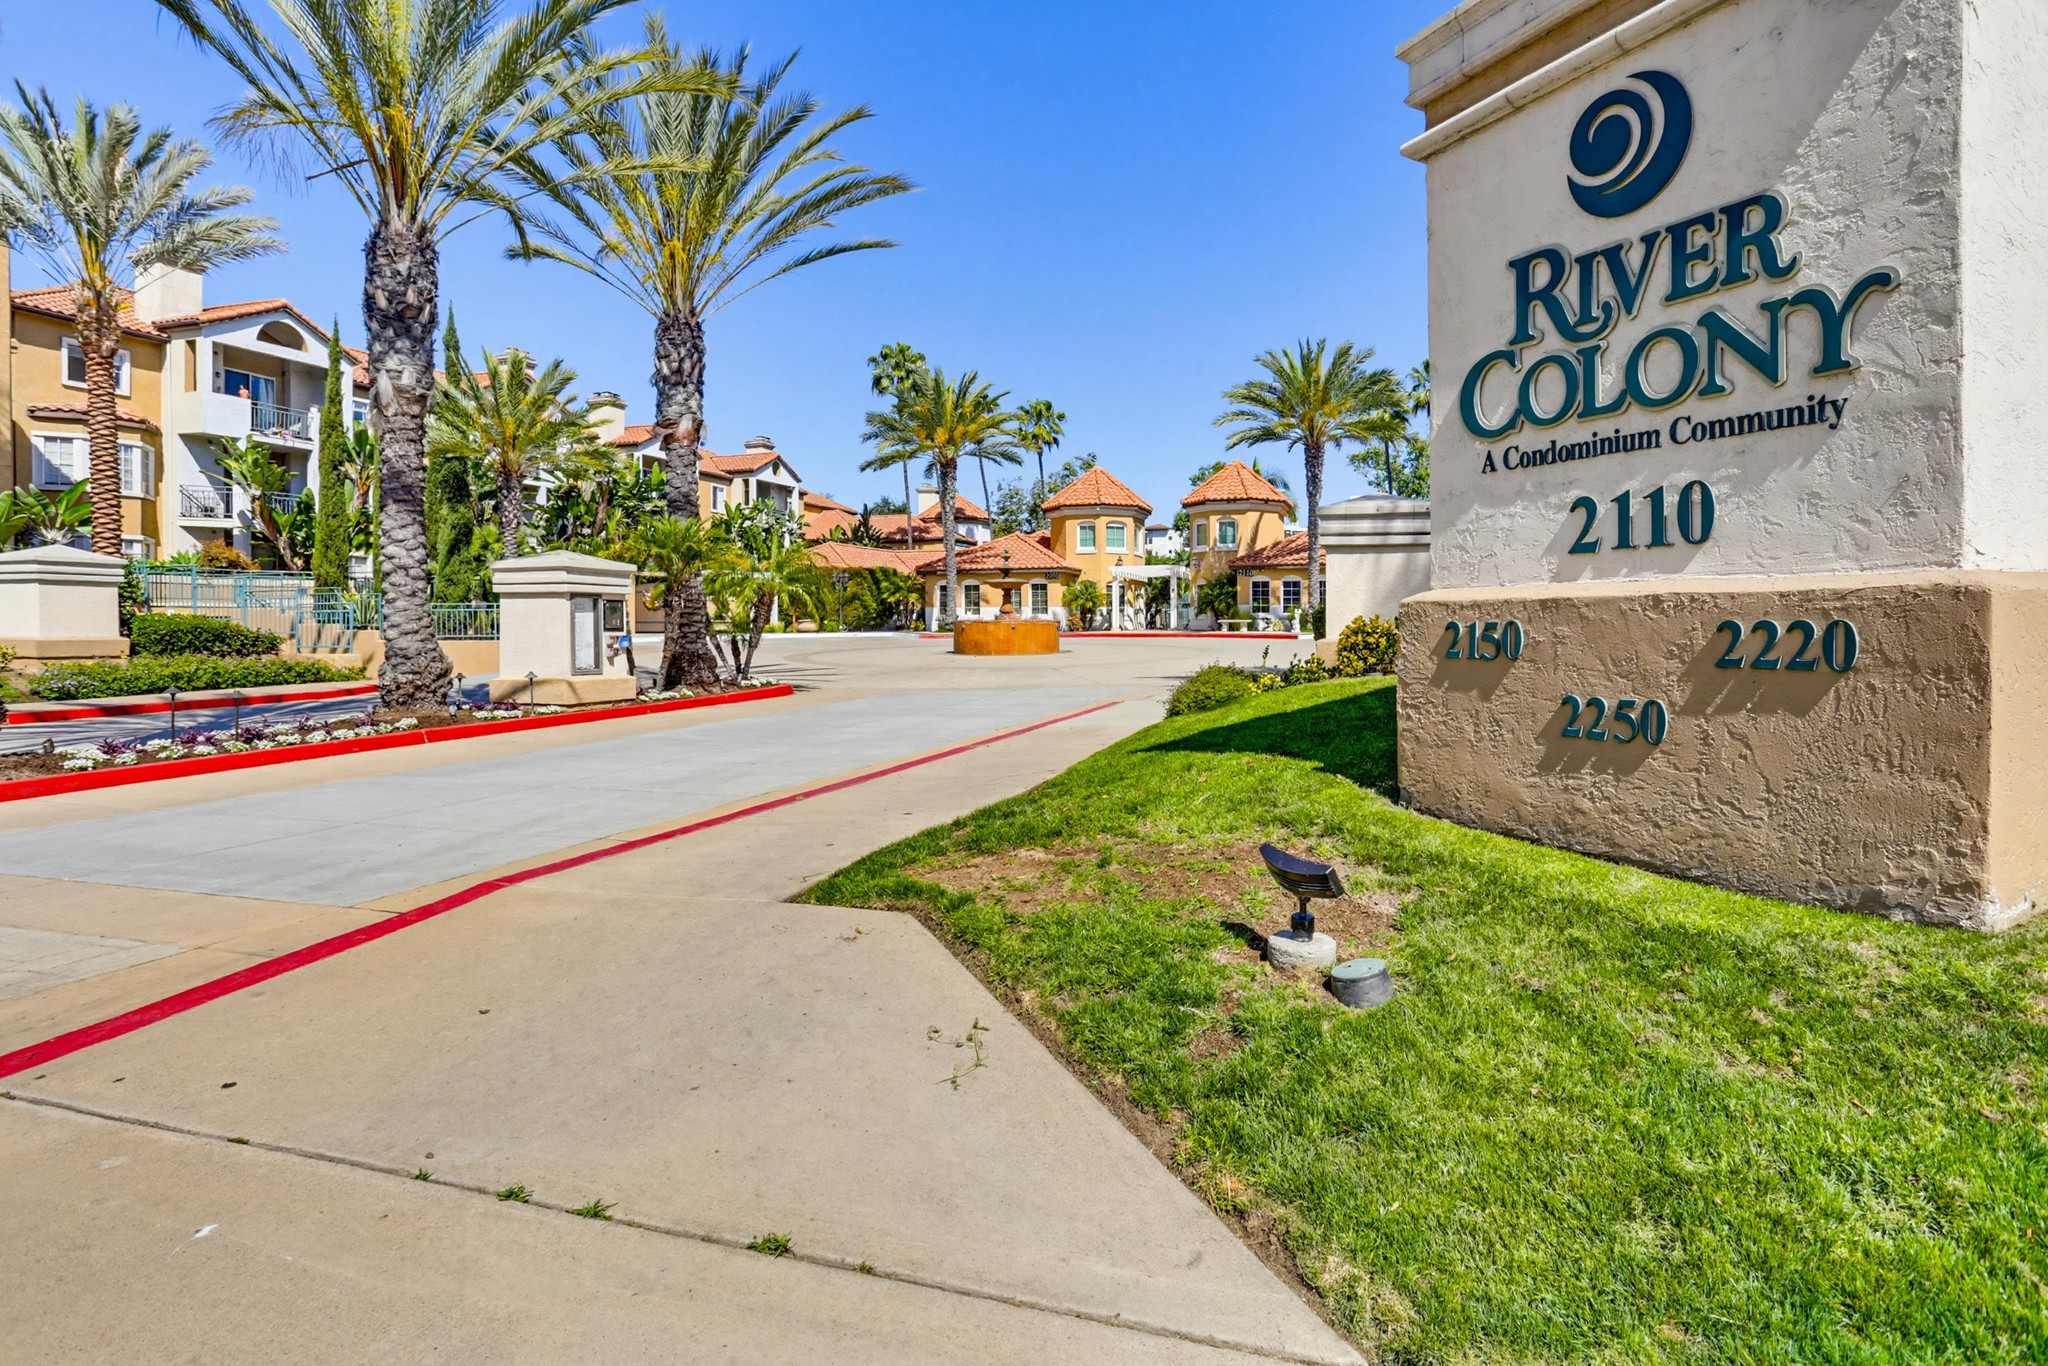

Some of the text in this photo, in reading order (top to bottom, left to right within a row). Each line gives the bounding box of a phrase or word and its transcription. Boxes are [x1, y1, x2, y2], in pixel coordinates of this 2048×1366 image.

[1508, 191, 1802, 346] RIVER
[1459, 266, 1901, 440] COLONY
[1481, 393, 1848, 474] A Condominium Community
[1568, 479, 1716, 555] 2110
[1444, 619, 1524, 661] 2150
[1714, 618, 1860, 673] 2220
[1560, 694, 1669, 746] 2250
